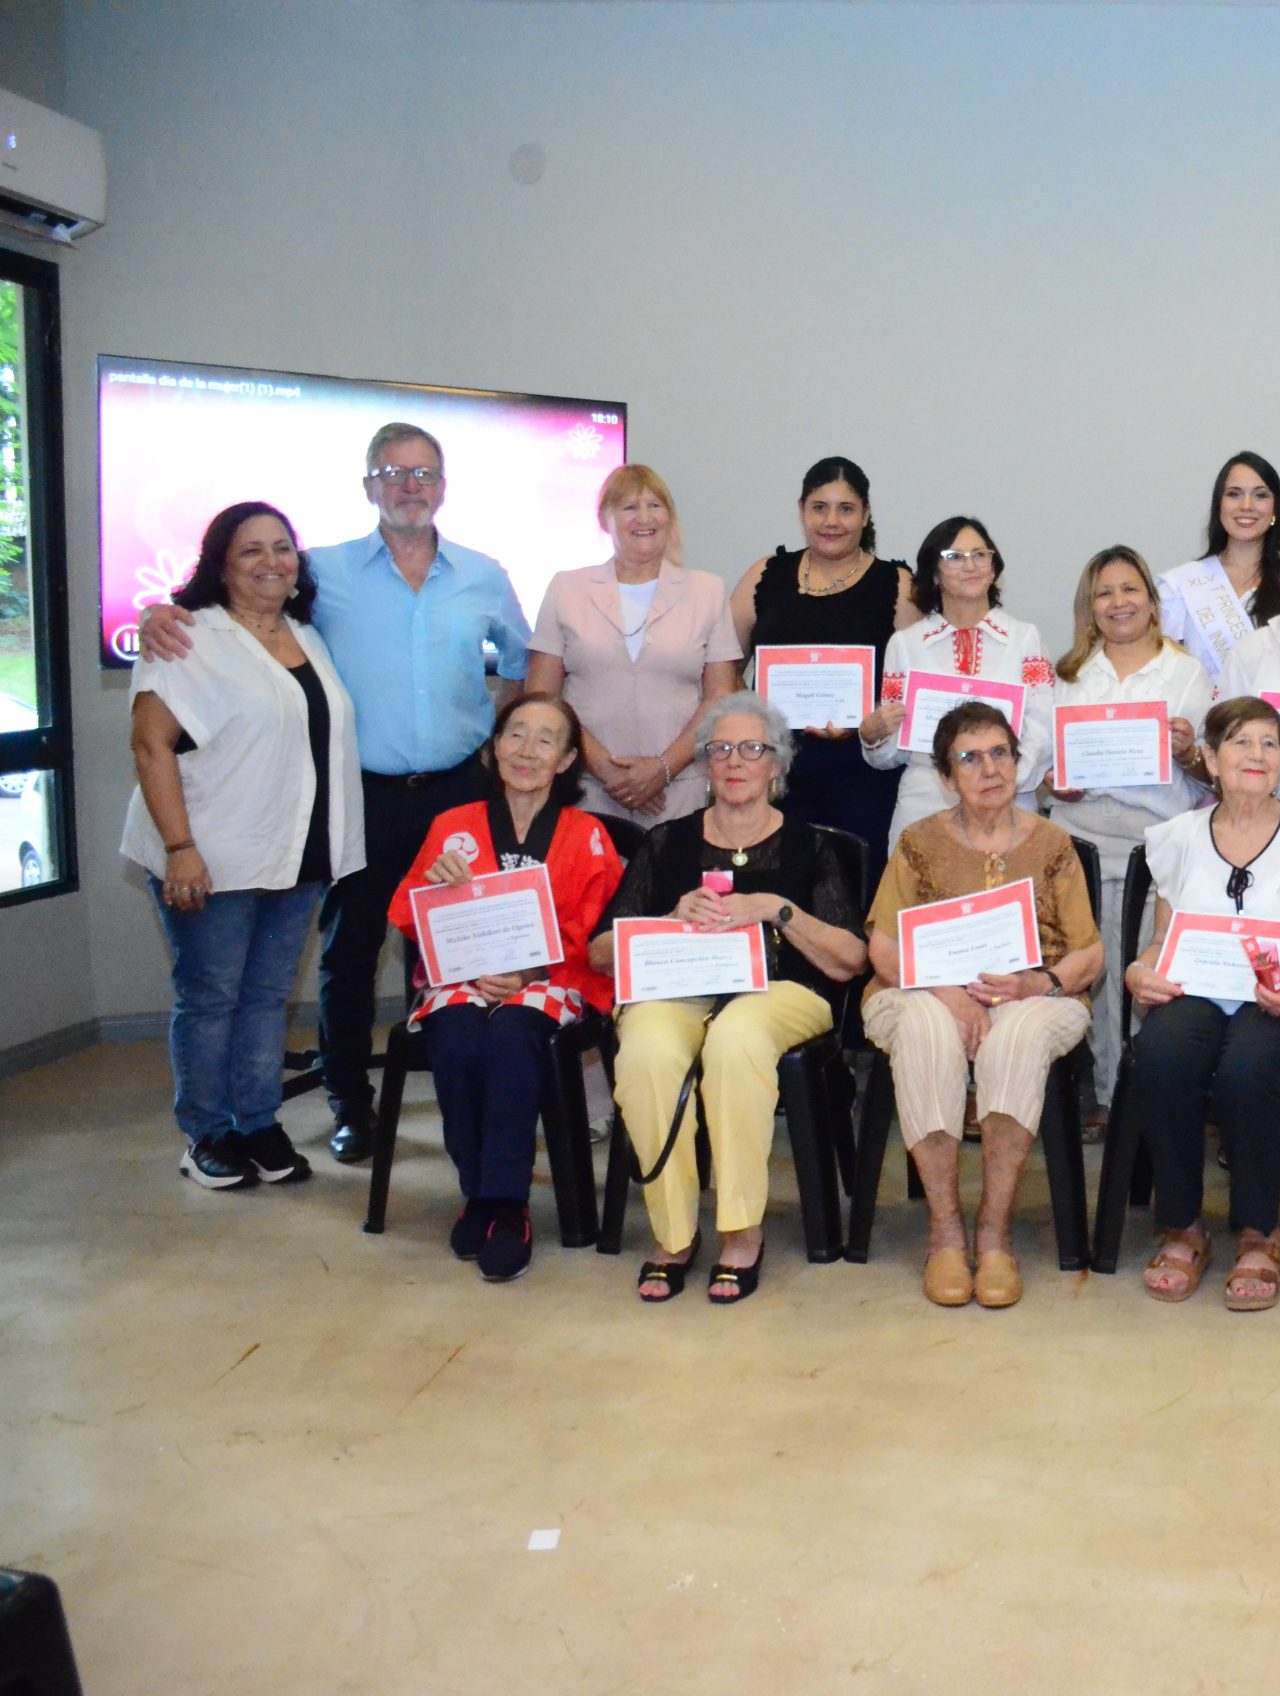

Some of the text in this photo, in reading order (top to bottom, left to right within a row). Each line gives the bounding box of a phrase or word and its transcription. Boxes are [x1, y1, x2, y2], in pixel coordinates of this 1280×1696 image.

[109, 372, 156, 385] pantalla
[179, 378, 193, 388] de
[195, 379, 206, 389] la
[208, 381, 255, 396] mujer(1)
[258, 383, 301, 399] (1).mp4
[591, 413, 618, 424] 18:10
[1195, 606, 1216, 630] DEL
